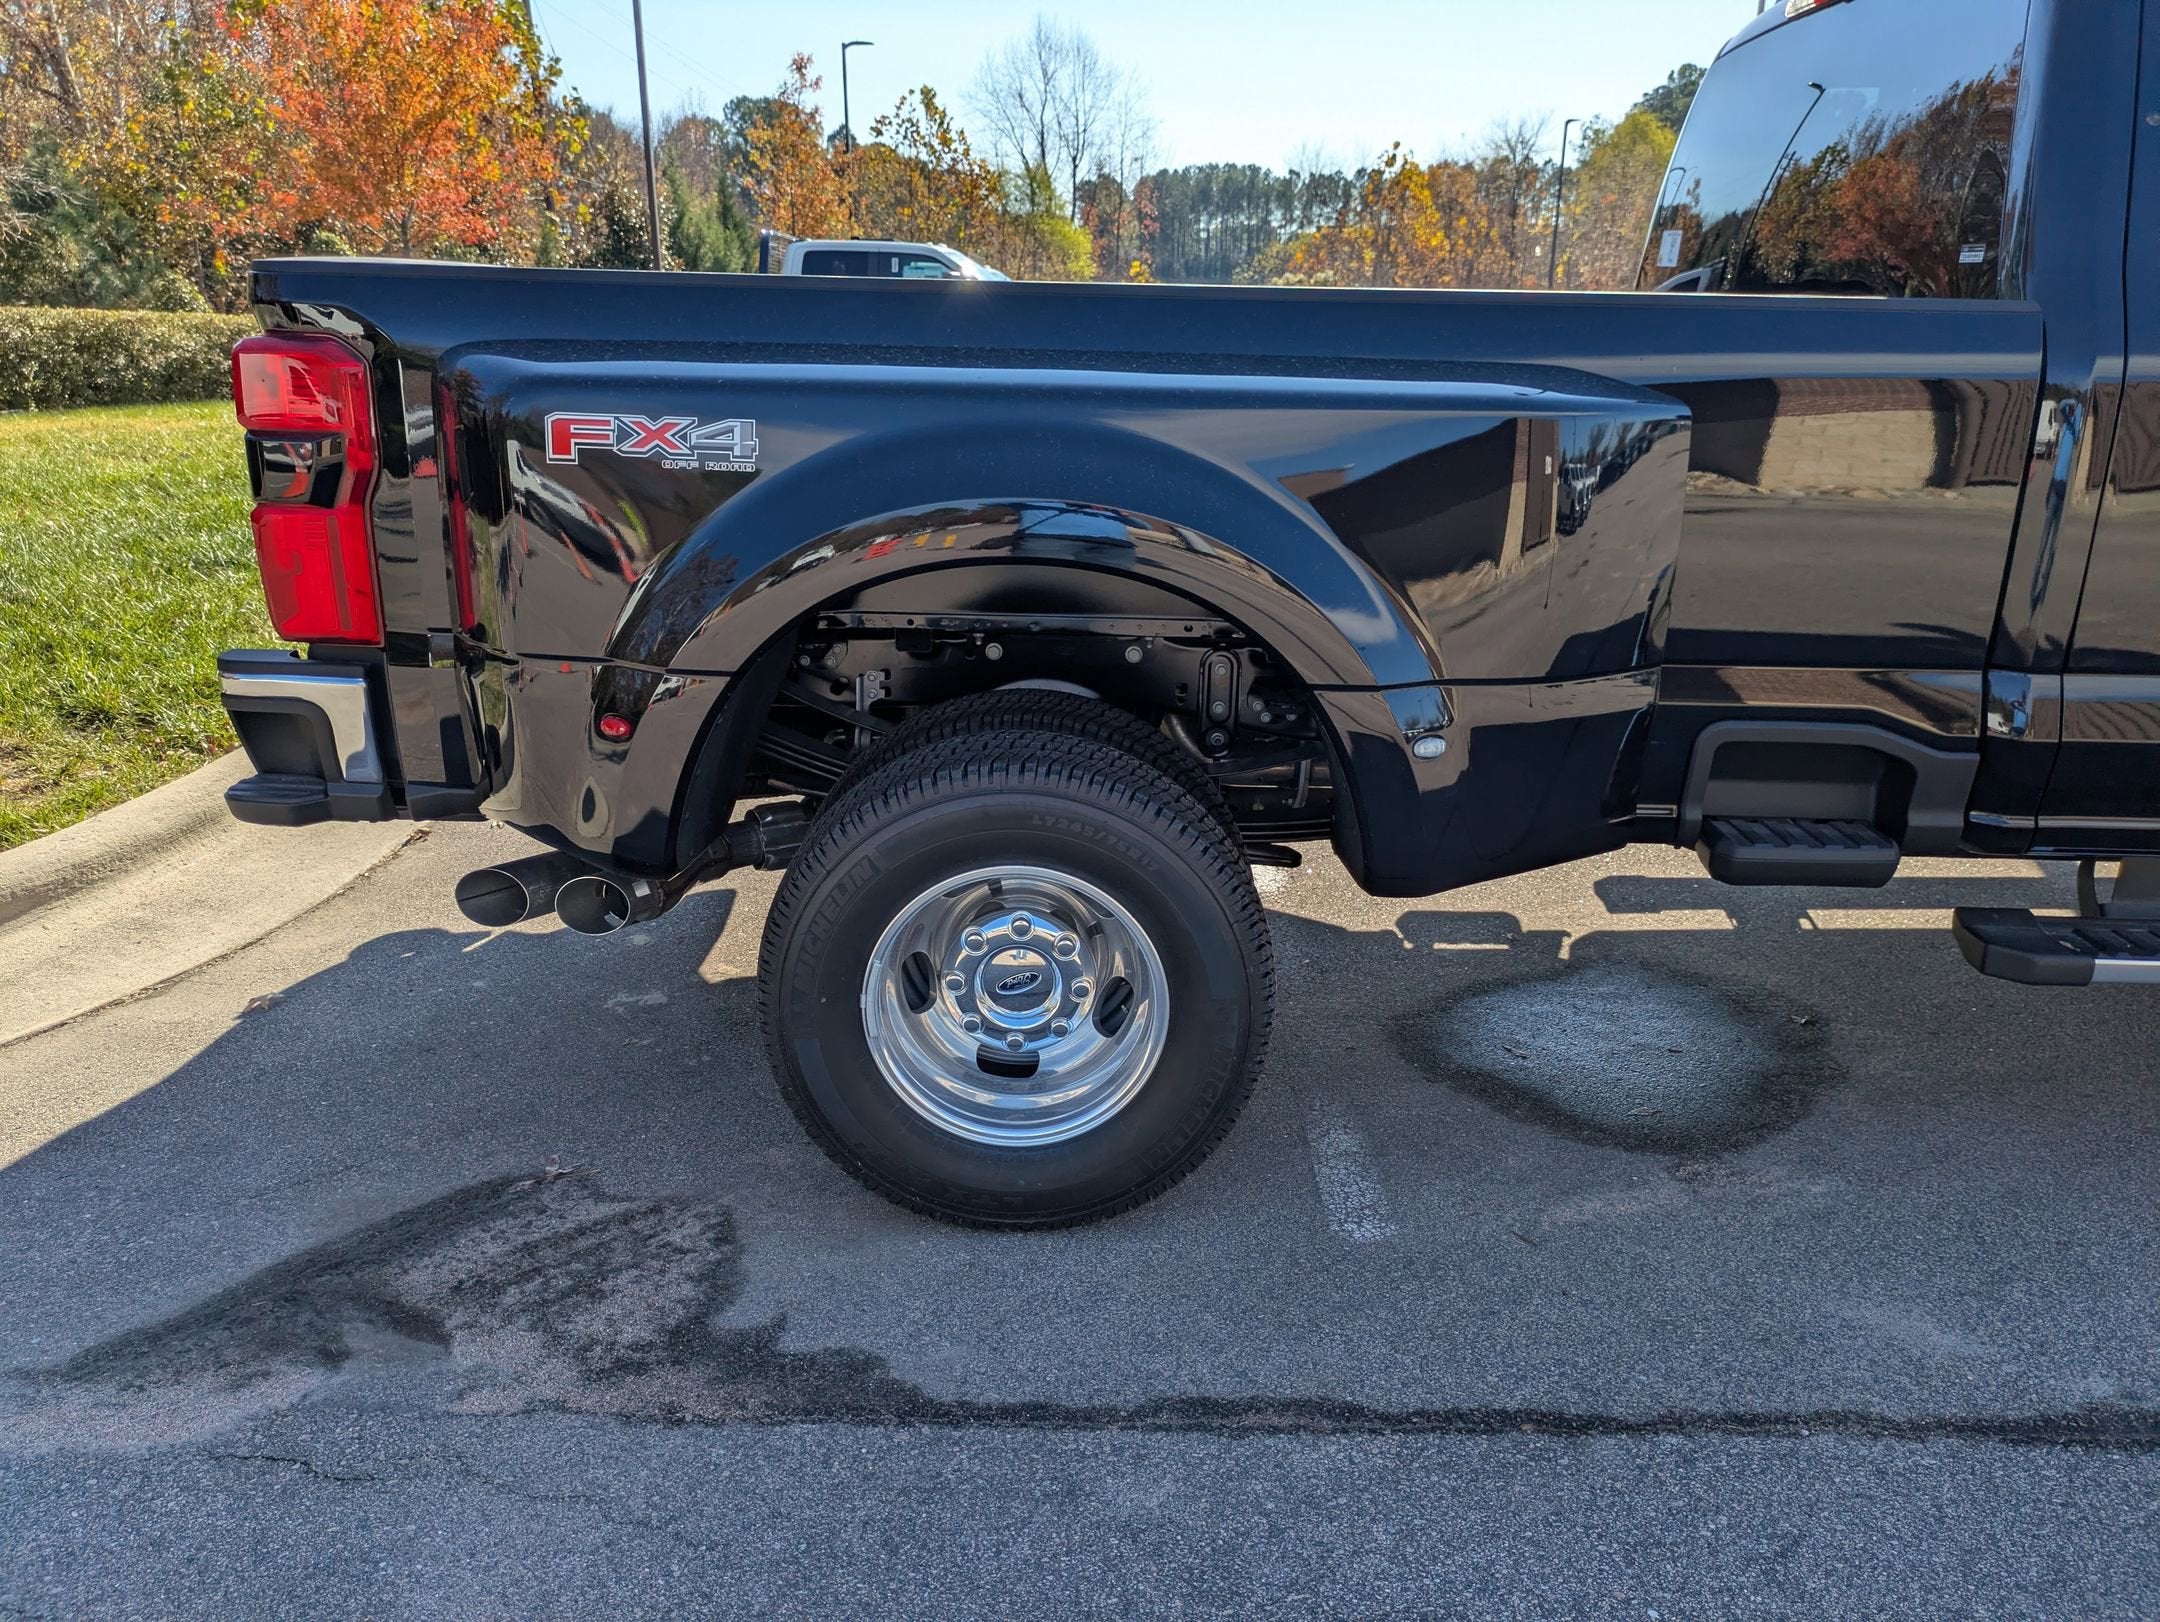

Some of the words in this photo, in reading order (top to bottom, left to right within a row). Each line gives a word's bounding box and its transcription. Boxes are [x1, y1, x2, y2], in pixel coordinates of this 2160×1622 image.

[545, 412, 758, 464] FX4
[661, 459, 699, 469] OFF
[705, 461, 756, 473] ROAD
[792, 857, 876, 991] MICHELIN
